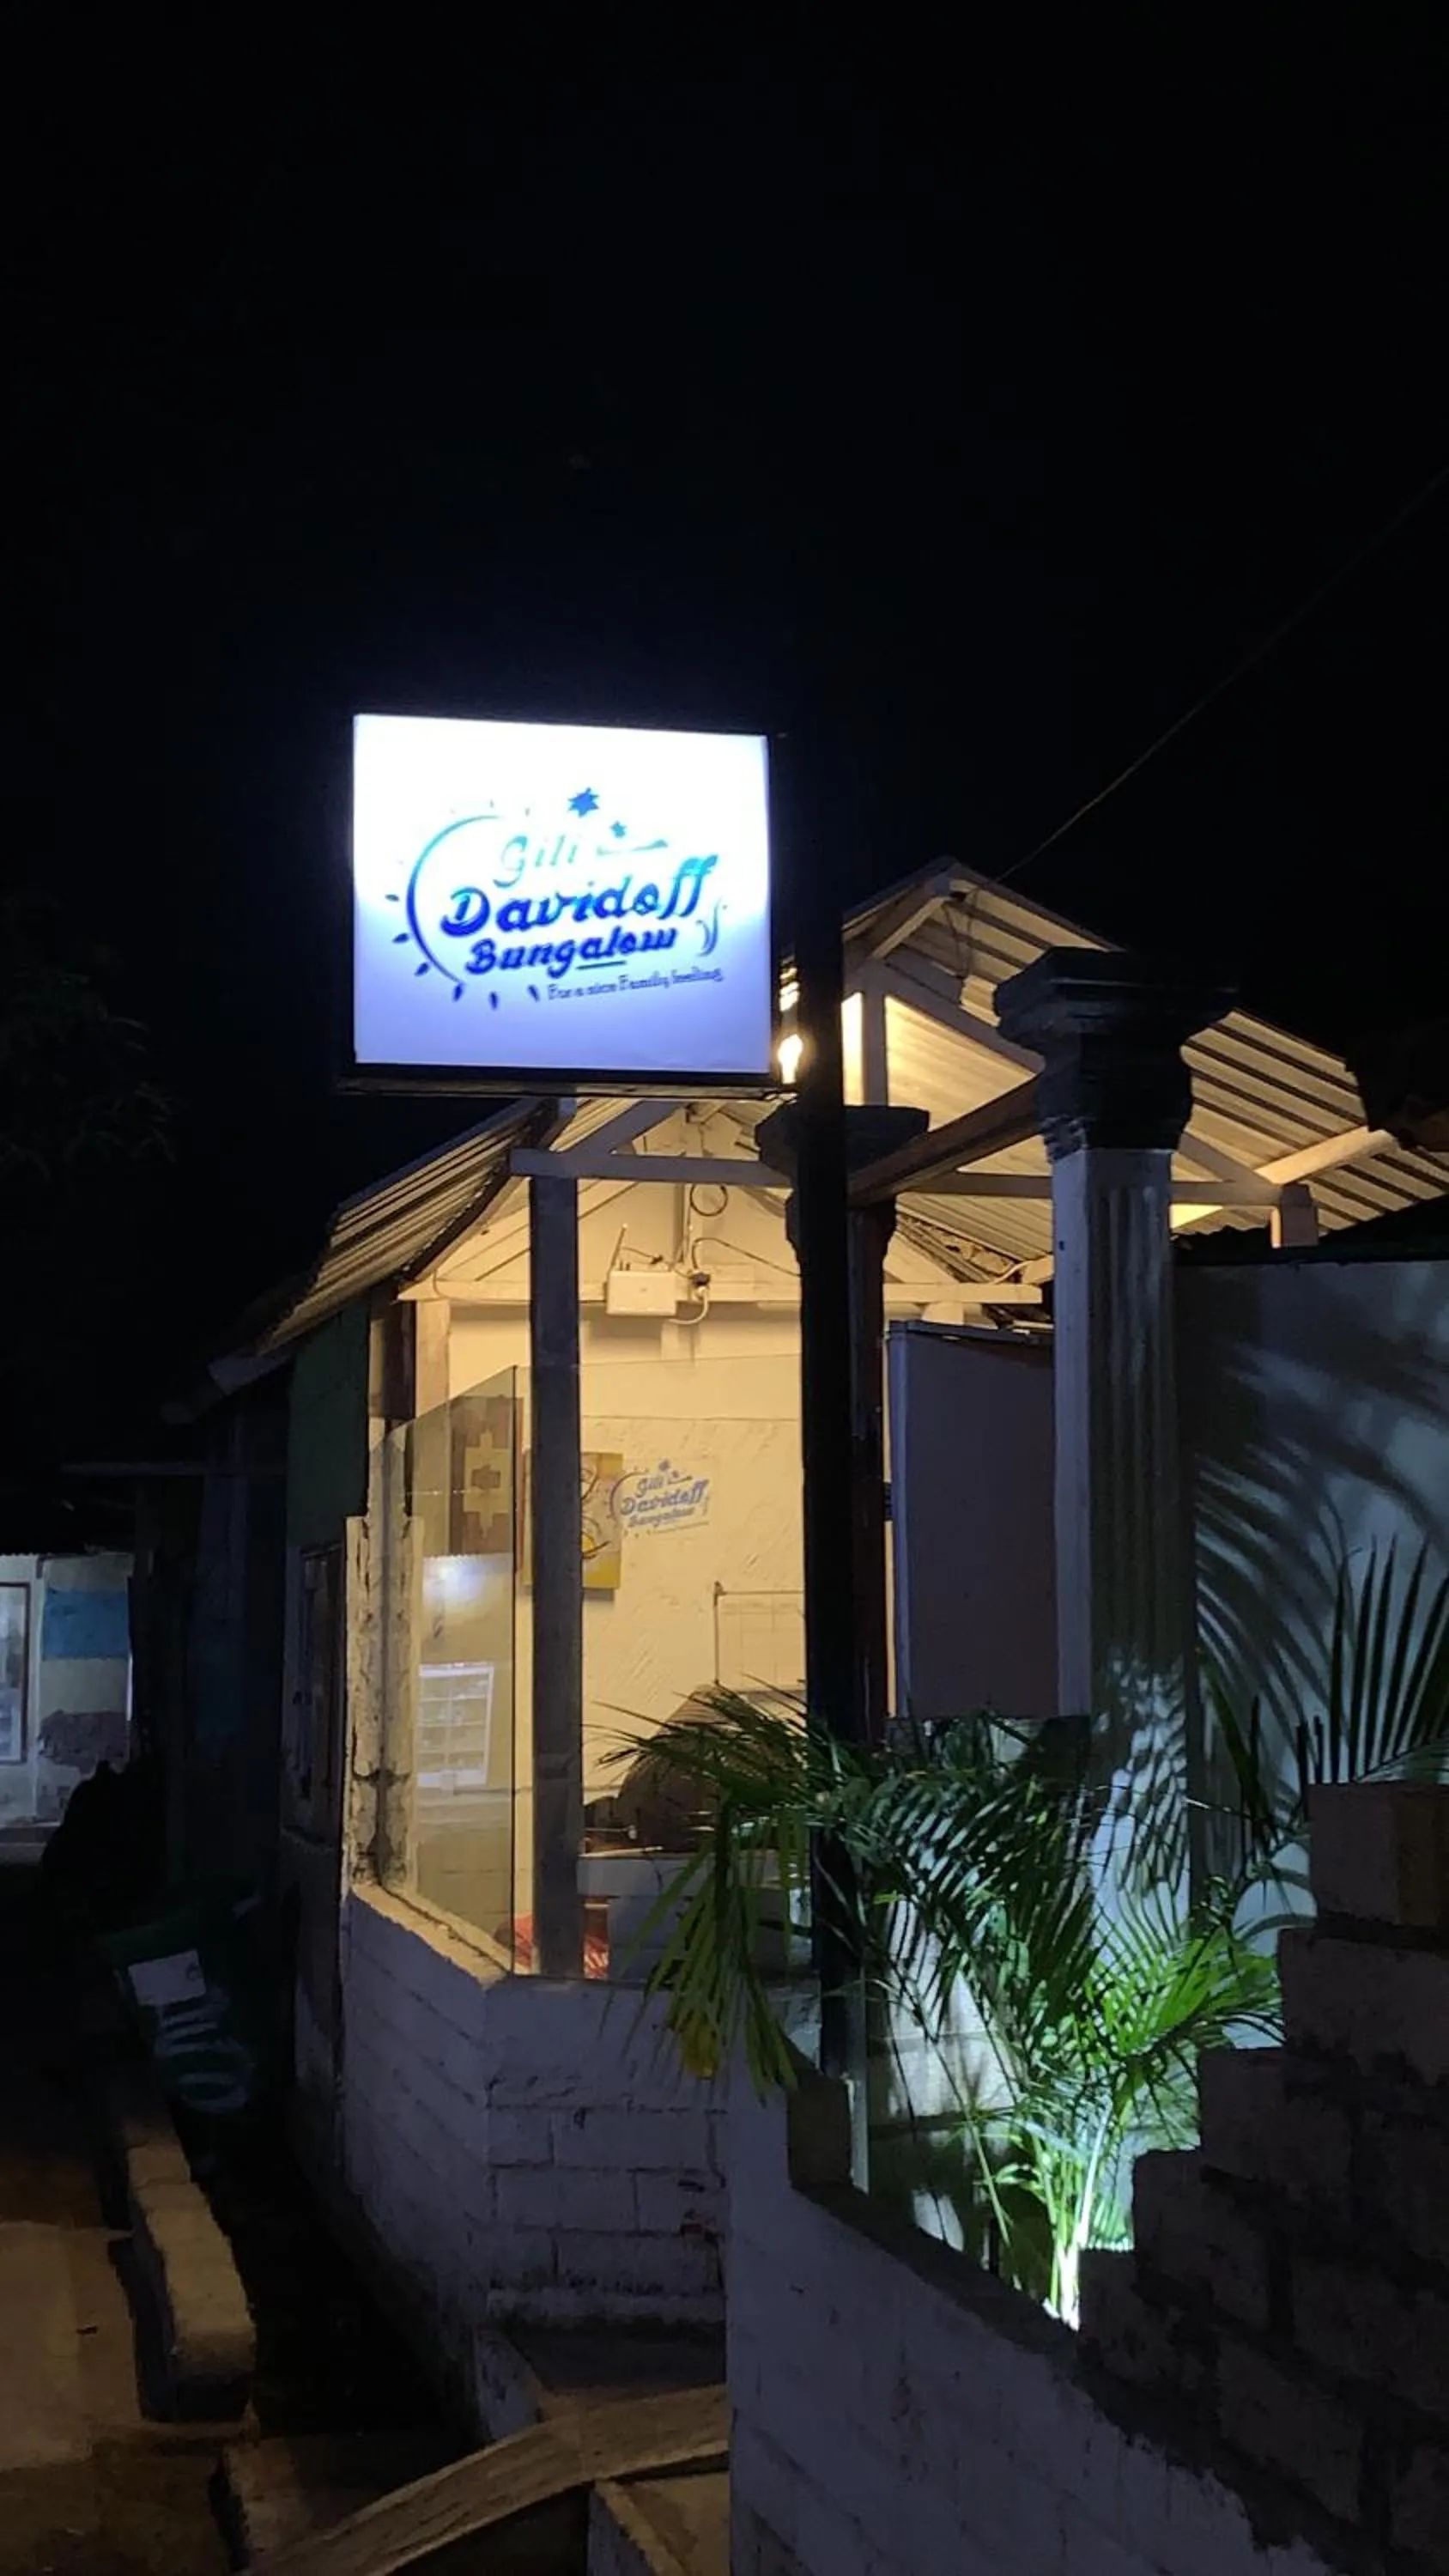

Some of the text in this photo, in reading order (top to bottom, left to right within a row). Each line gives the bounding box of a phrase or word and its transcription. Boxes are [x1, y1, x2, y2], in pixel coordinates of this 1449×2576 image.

[493, 835, 578, 888] Gili
[440, 854, 719, 937] Davidoff
[464, 925, 678, 980] Bungalow
[548, 983, 572, 1000] For
[619, 974, 670, 991] Family
[621, 1479, 709, 1515] Davidoff
